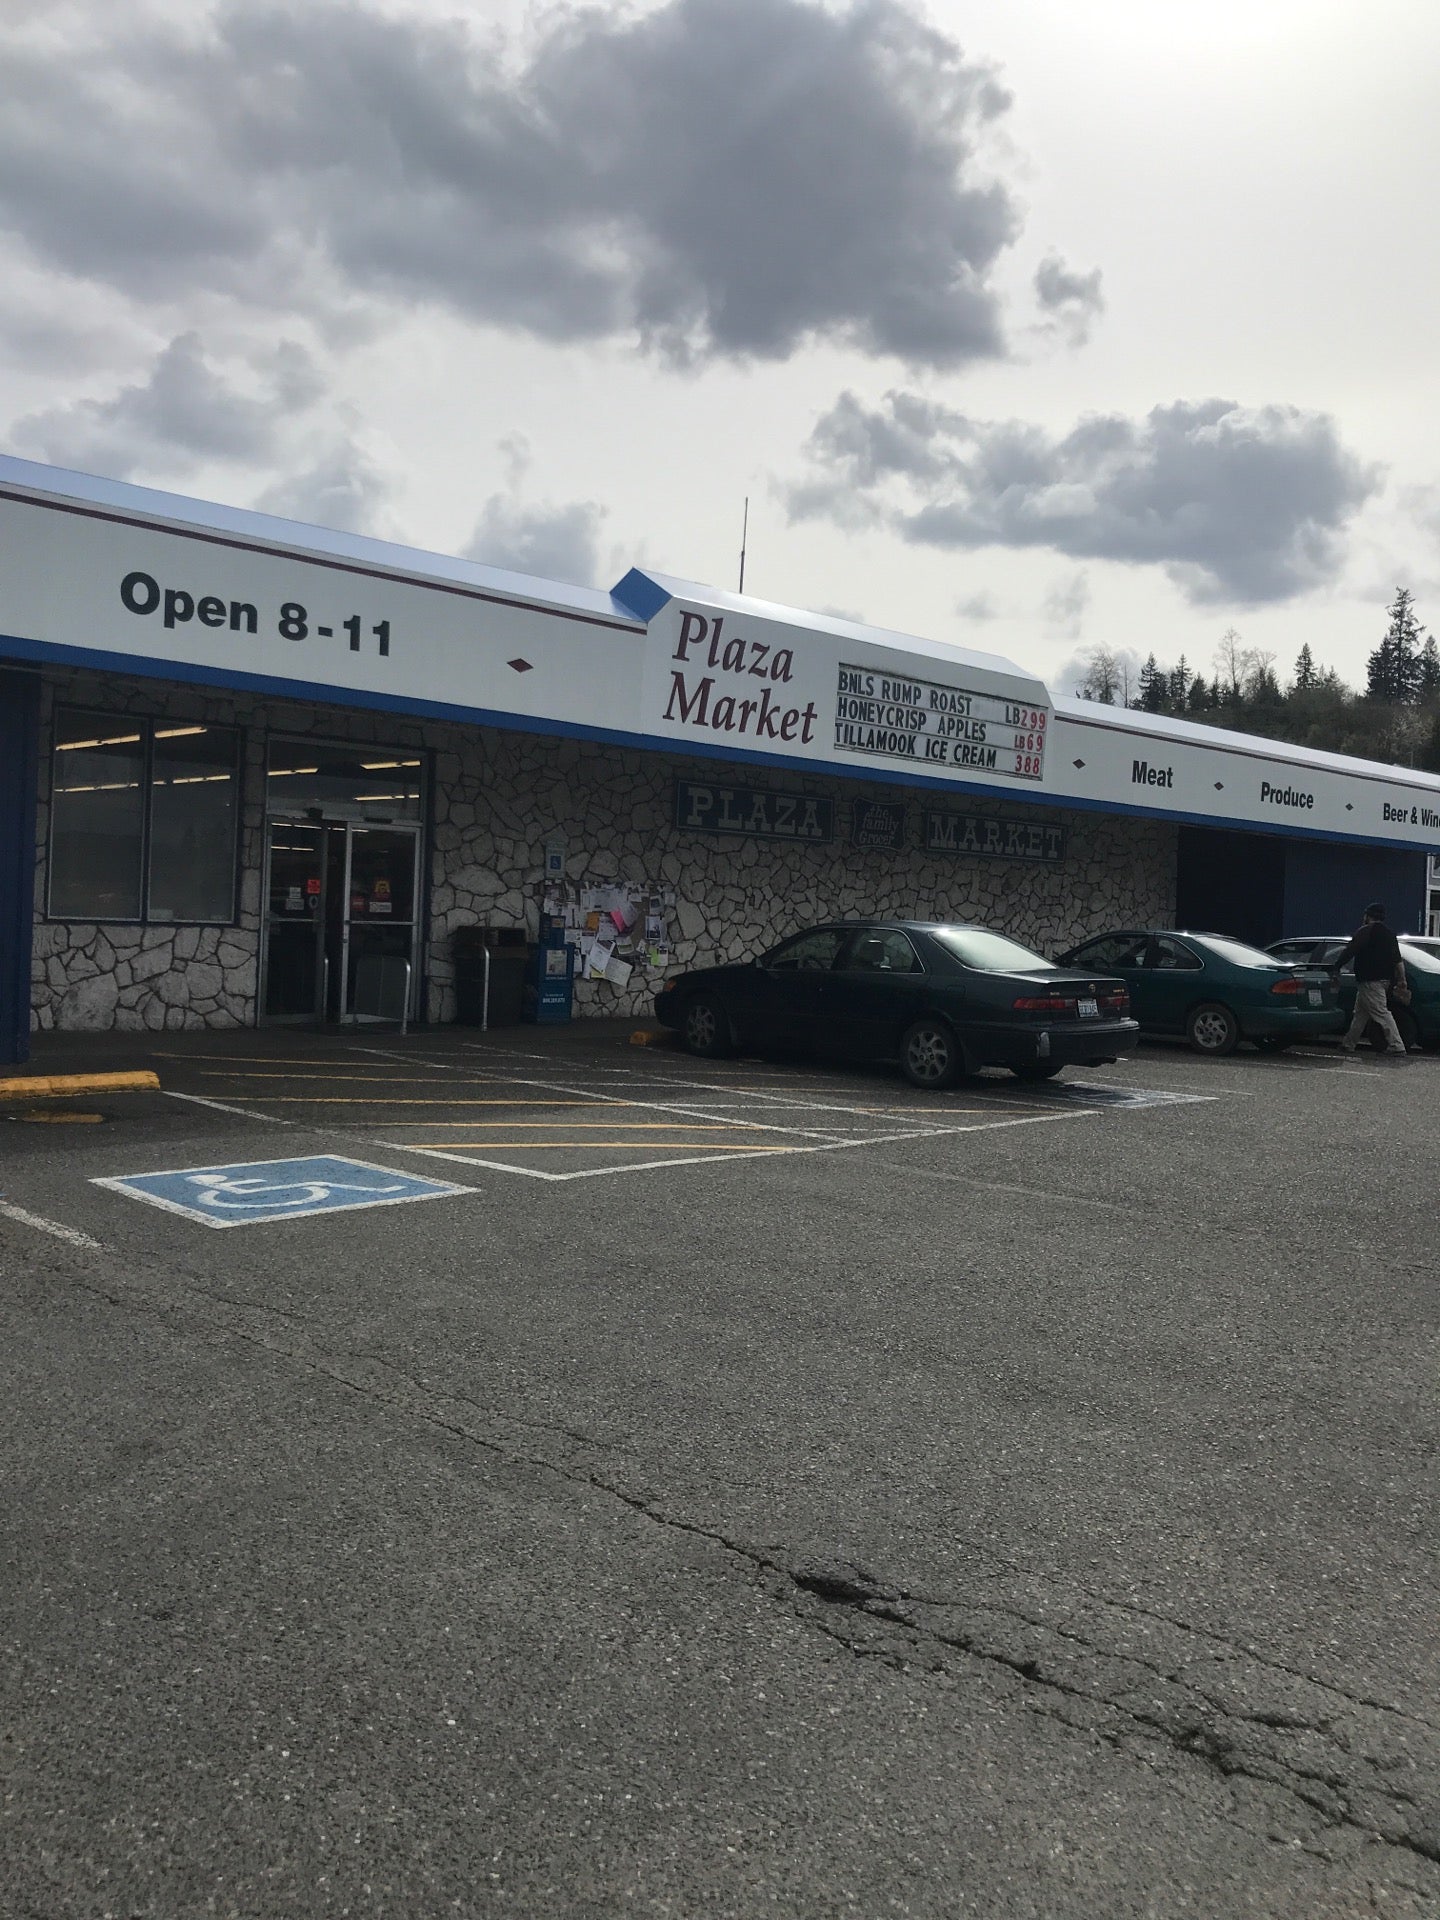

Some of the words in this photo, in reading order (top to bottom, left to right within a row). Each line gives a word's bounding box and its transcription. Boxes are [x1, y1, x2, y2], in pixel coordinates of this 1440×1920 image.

[120, 571, 258, 634] Open
[278, 602, 390, 657] 8-11
[672, 610, 794, 683] Plaza
[662, 670, 818, 744] Market
[838, 670, 875, 697] BNLS
[881, 679, 922, 706] RUMP
[930, 689, 972, 716] ROAST
[837, 696, 927, 731] HONEYCRISP
[937, 715, 987, 742] APPLES
[834, 722, 917, 755] TILLAMOOK
[925, 738, 949, 761] ICE
[953, 743, 997, 769] CREAM
[1014, 754, 1040, 775] 388
[1131, 760, 1174, 788] Meat
[1260, 781, 1314, 809] Produce
[686, 786, 823, 837] PLAZA
[861, 811, 900, 835] family
[869, 804, 889, 818] the
[1383, 802, 1409, 823] Beer
[1410, 805, 1418, 824] &
[1421, 807, 1440, 828] Win
[858, 830, 895, 846] Grocer
[929, 814, 1062, 859] MARKET
